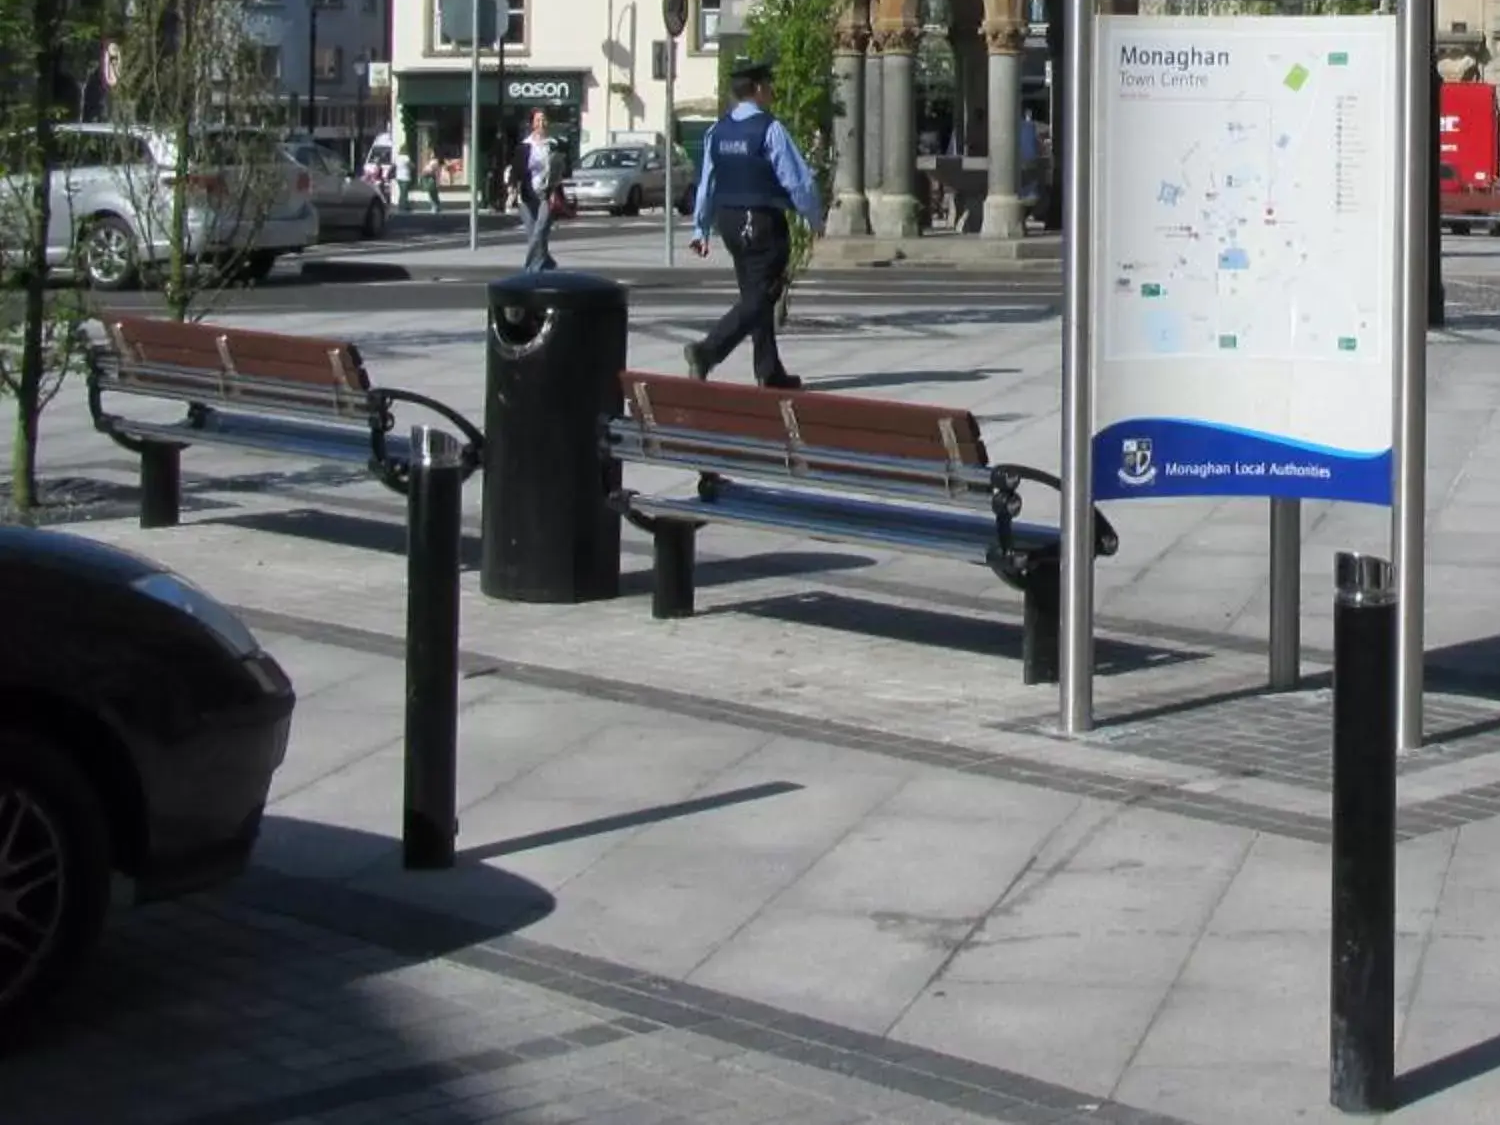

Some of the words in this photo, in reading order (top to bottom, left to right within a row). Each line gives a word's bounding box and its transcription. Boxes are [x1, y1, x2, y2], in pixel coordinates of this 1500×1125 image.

[1120, 44, 1230, 71] Monaghan
[1120, 70, 1155, 88] Town
[1160, 71, 1208, 88] Centre
[508, 81, 569, 98] eason
[1165, 462, 1231, 479] Monaghan
[1235, 461, 1265, 476] Local
[1269, 461, 1332, 479] Authorities
